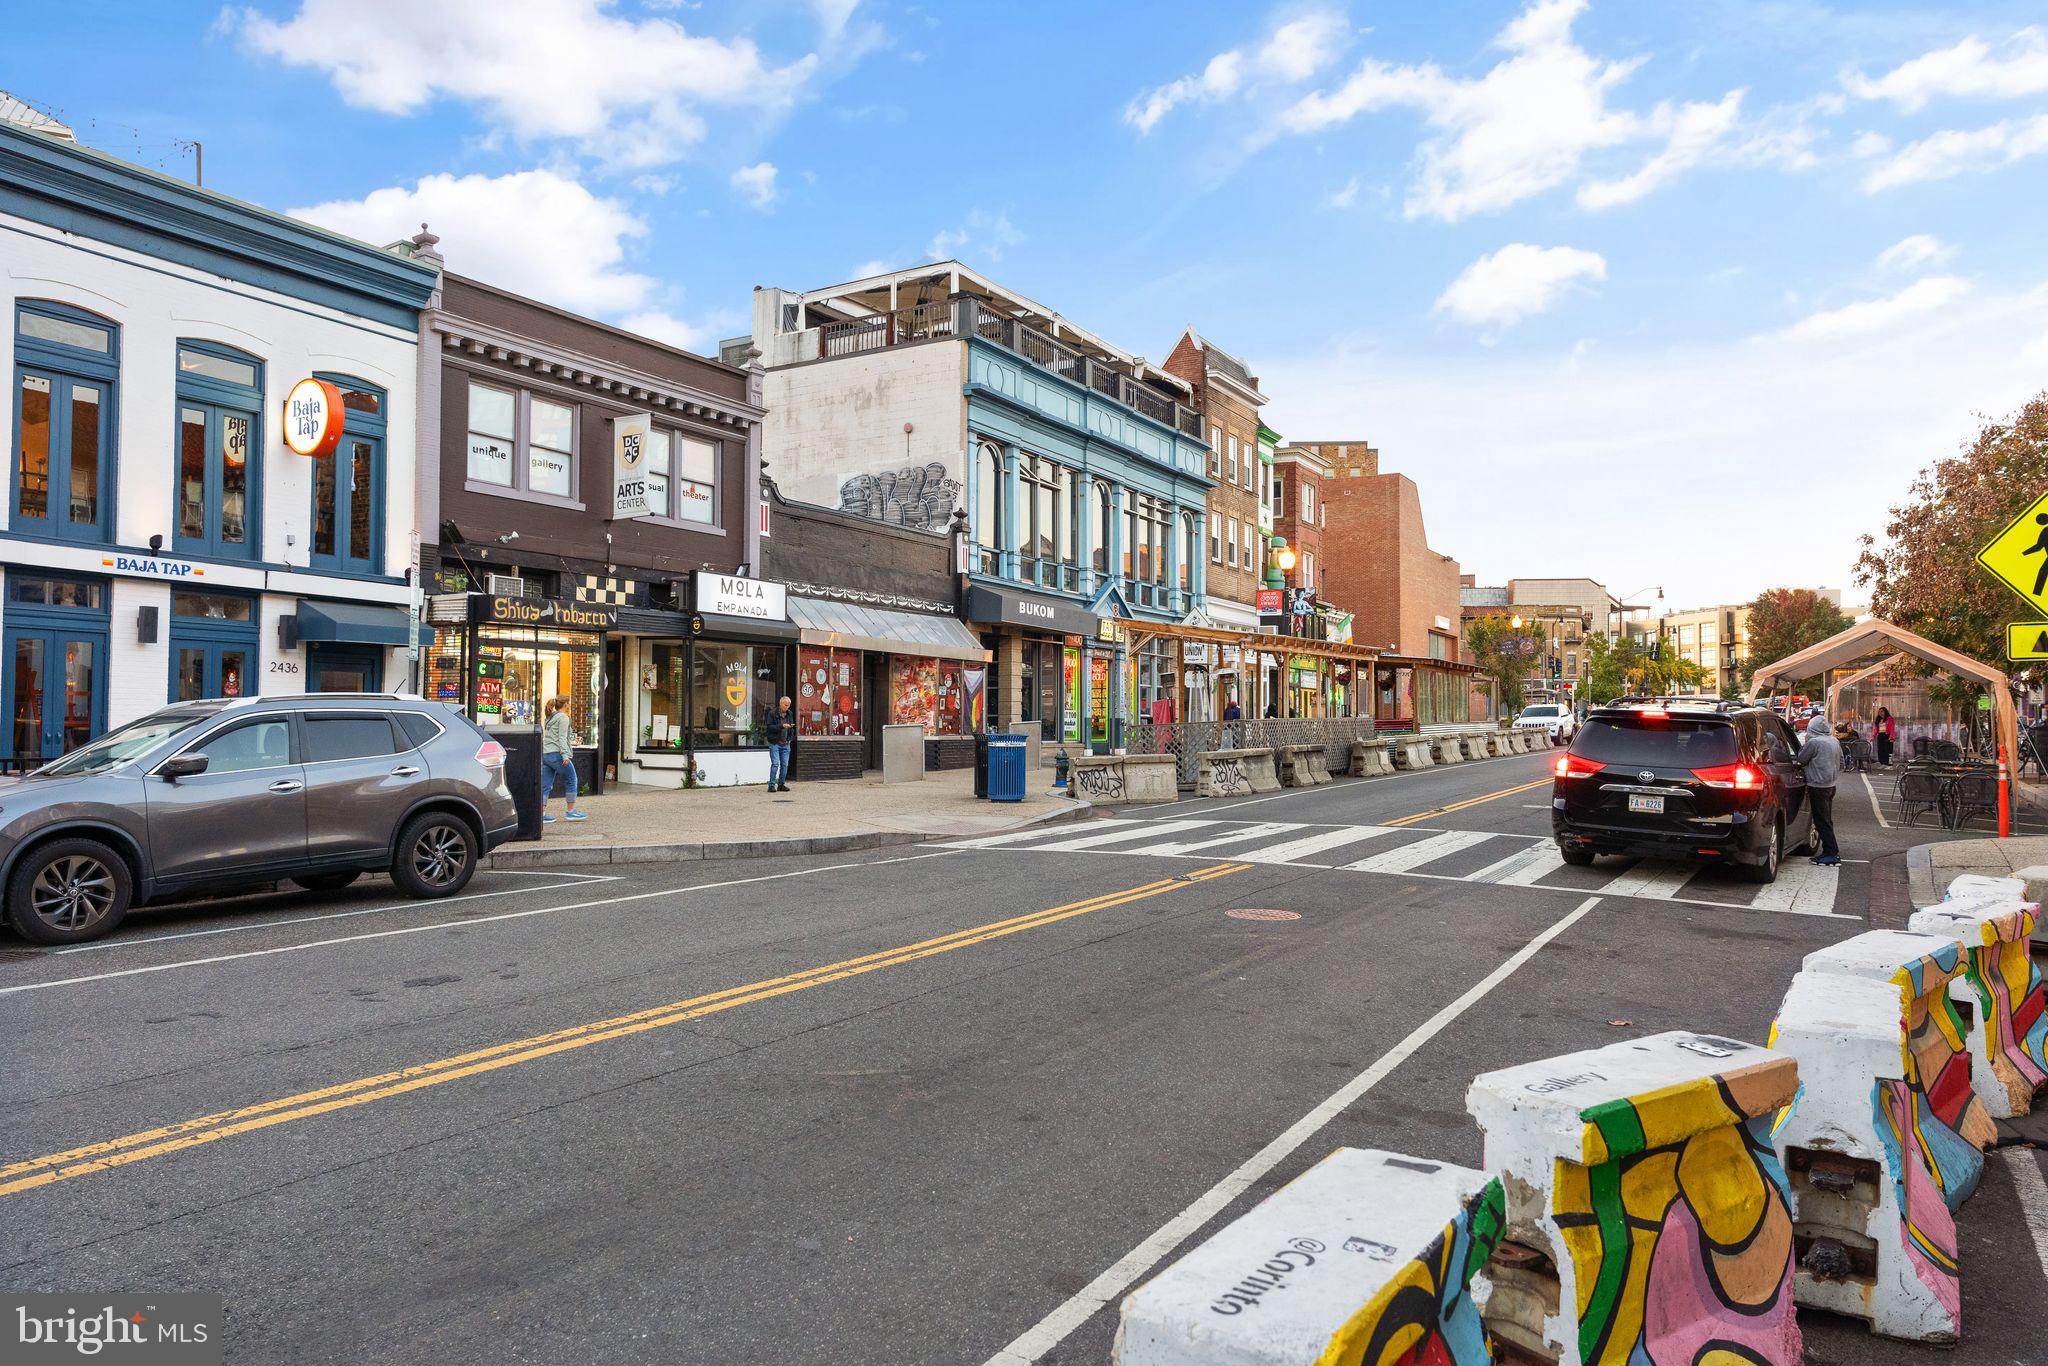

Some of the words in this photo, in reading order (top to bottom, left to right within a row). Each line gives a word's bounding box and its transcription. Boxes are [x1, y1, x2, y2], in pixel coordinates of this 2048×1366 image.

[293, 397, 321, 420] Baja
[296, 416, 319, 440] Tap
[472, 446, 507, 460] unique
[531, 458, 563, 472] gallery
[617, 481, 645, 499] ARTS
[682, 490, 709, 501] theater
[617, 497, 646, 510] CENTER
[116, 557, 159, 574] BAJA
[160, 562, 192, 576] TAP
[717, 601, 768, 617] EMPANADA
[1019, 601, 1055, 619] BUKOM
[270, 661, 299, 674] 2436
[480, 682, 501, 693] ATM
[476, 696, 501, 706] SMOKE
[477, 704, 499, 713] PIPES
[1524, 1070, 1608, 1096] Gallery
[1210, 1236, 1328, 1317] @Corinto
